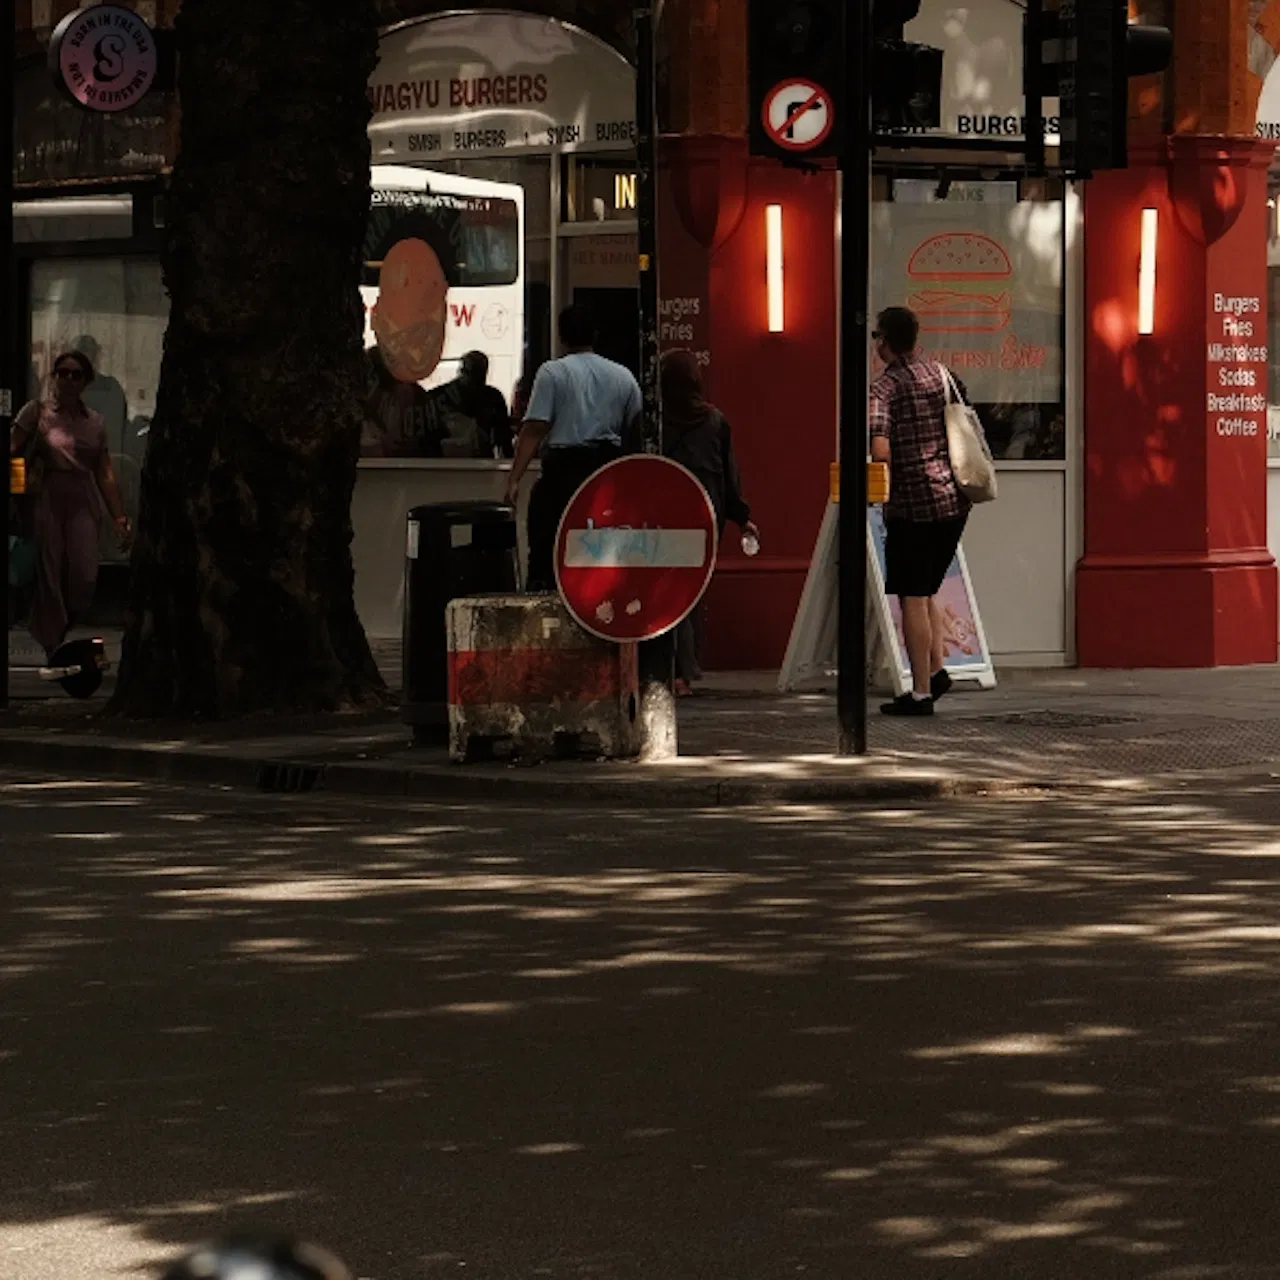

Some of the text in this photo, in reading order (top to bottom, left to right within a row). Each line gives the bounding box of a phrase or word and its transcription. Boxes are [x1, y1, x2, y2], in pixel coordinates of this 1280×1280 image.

[93, 34, 126, 82] S
[450, 73, 547, 108] BURGERS
[454, 129, 506, 149] BURGERS
[597, 121, 637, 141] BURGE
[660, 297, 700, 322] urgers
[1213, 293, 1260, 317] Burgers
[660, 322, 694, 341] Fries
[1222, 317, 1254, 337] Fries
[1207, 342, 1268, 363] Milkshakes
[1218, 366, 1256, 387] Sodas
[1207, 392, 1266, 413] Breakfast
[1216, 416, 1258, 437] Coffee
